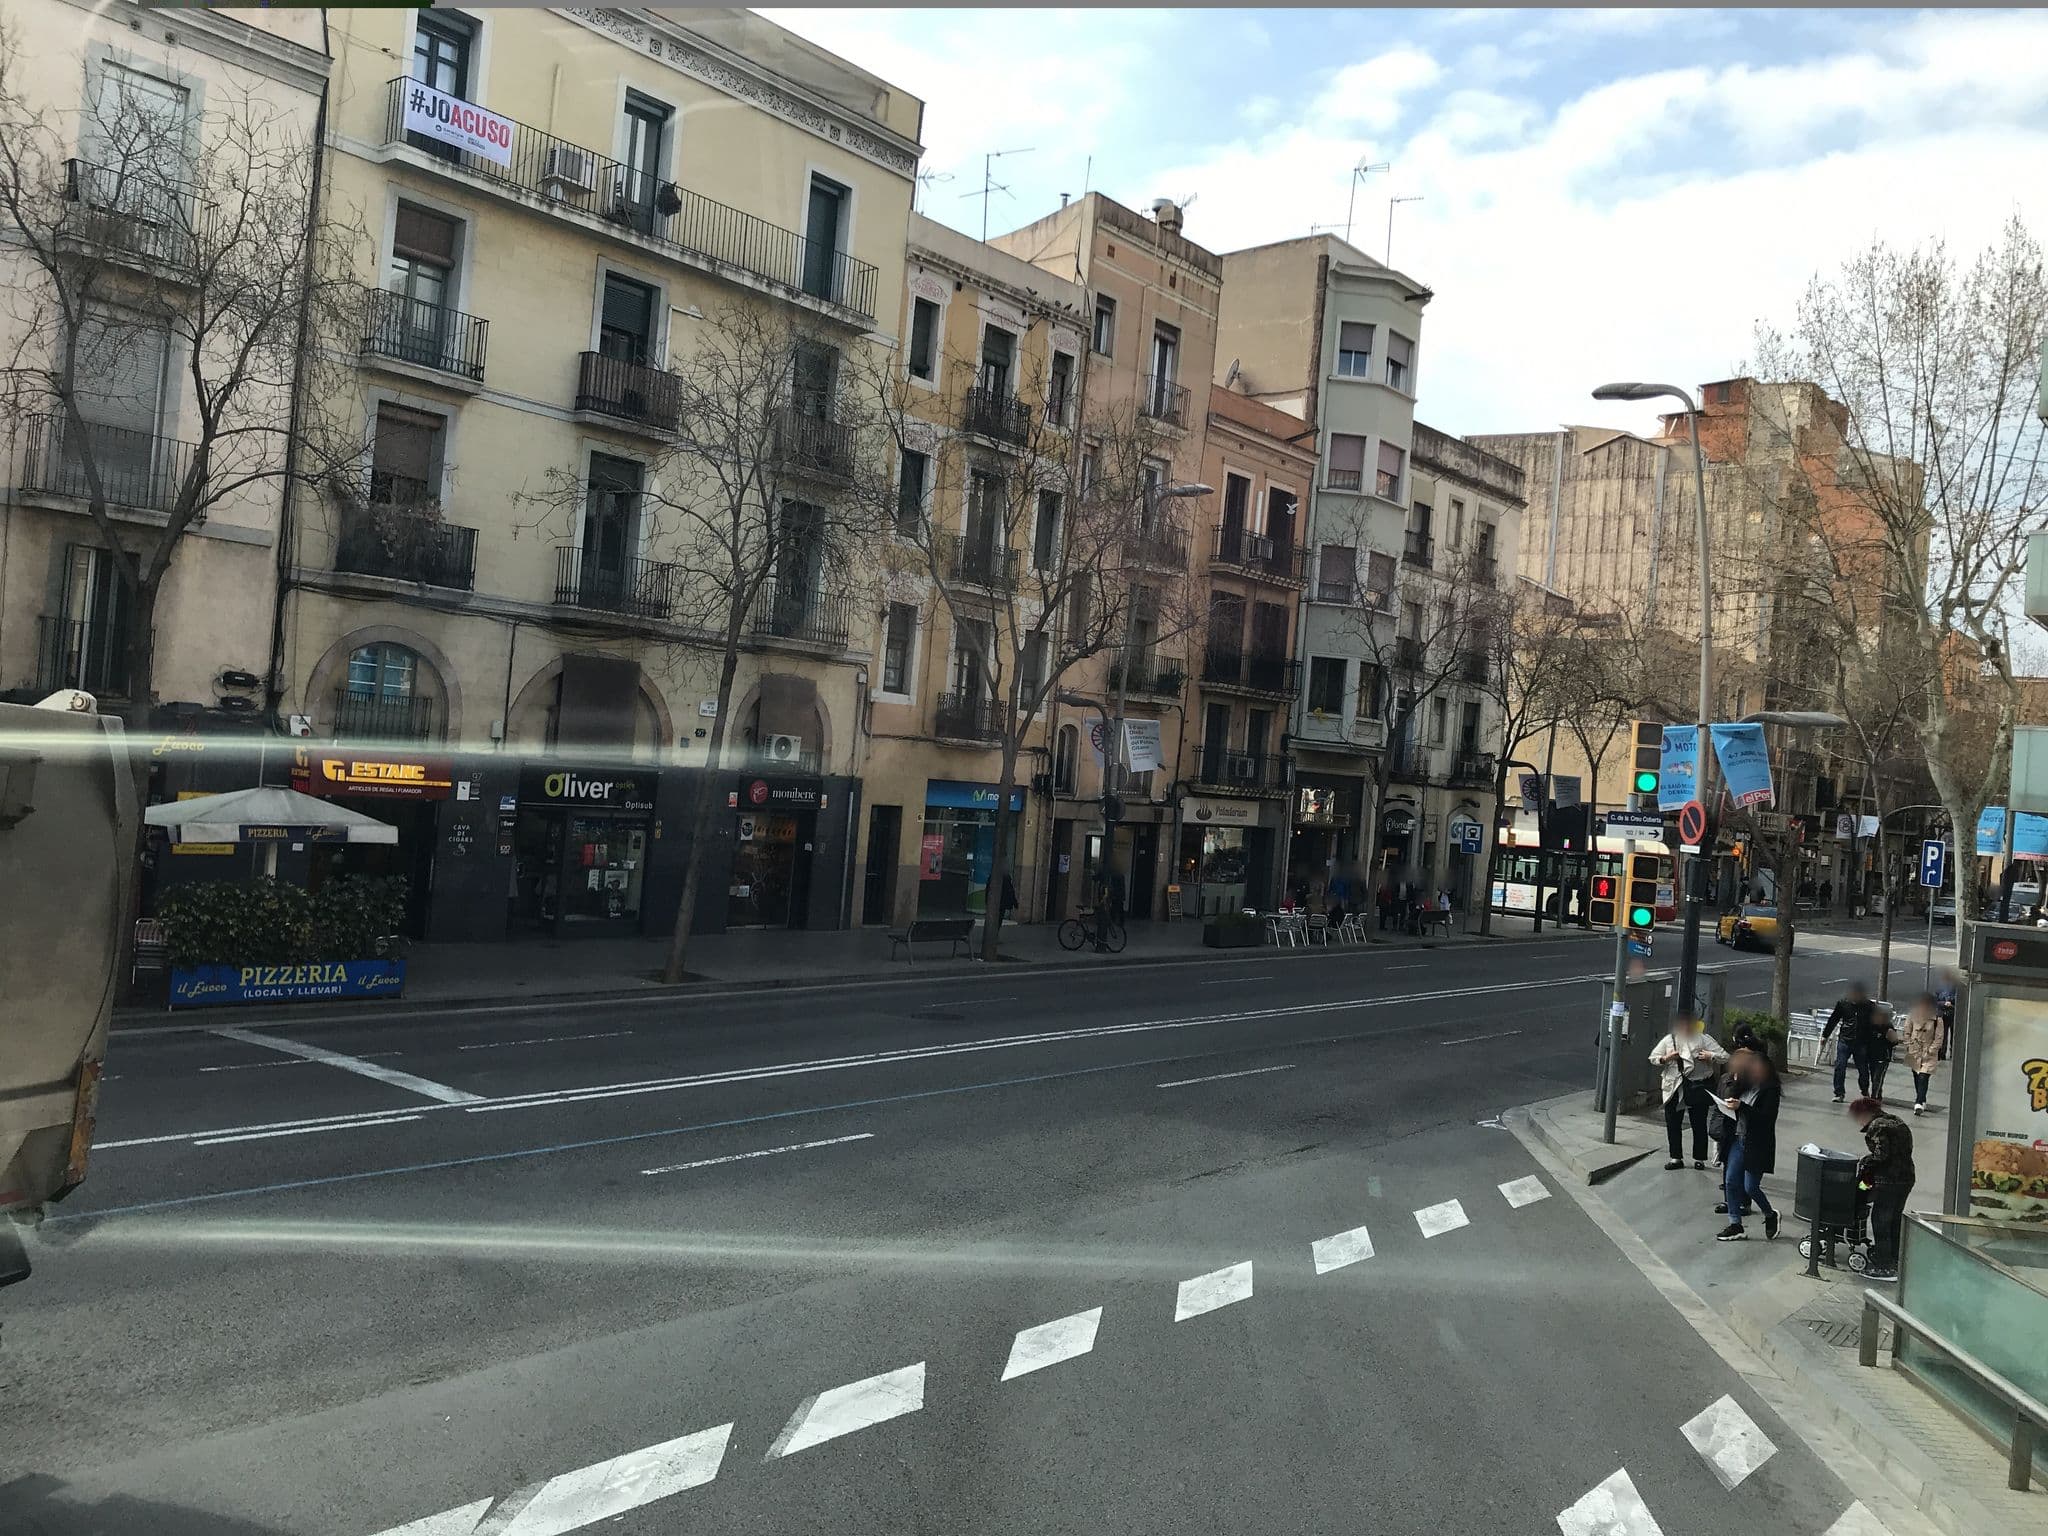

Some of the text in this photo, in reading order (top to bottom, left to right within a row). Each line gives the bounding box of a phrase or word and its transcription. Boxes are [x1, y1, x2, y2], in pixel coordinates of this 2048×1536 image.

[409, 88, 511, 149] #JOACUSO
[350, 761, 426, 780] ESTANC
[544, 772, 614, 800] Oliver
[625, 801, 653, 810] Optisub
[247, 827, 289, 838] PIZZERIA
[1926, 846, 1939, 867] P
[239, 964, 348, 987] PIZZERIA
[366, 974, 401, 990] Fuoco
[187, 981, 227, 999] Fuoco
[243, 985, 342, 999] (LOCAL Y LLEVAR)
